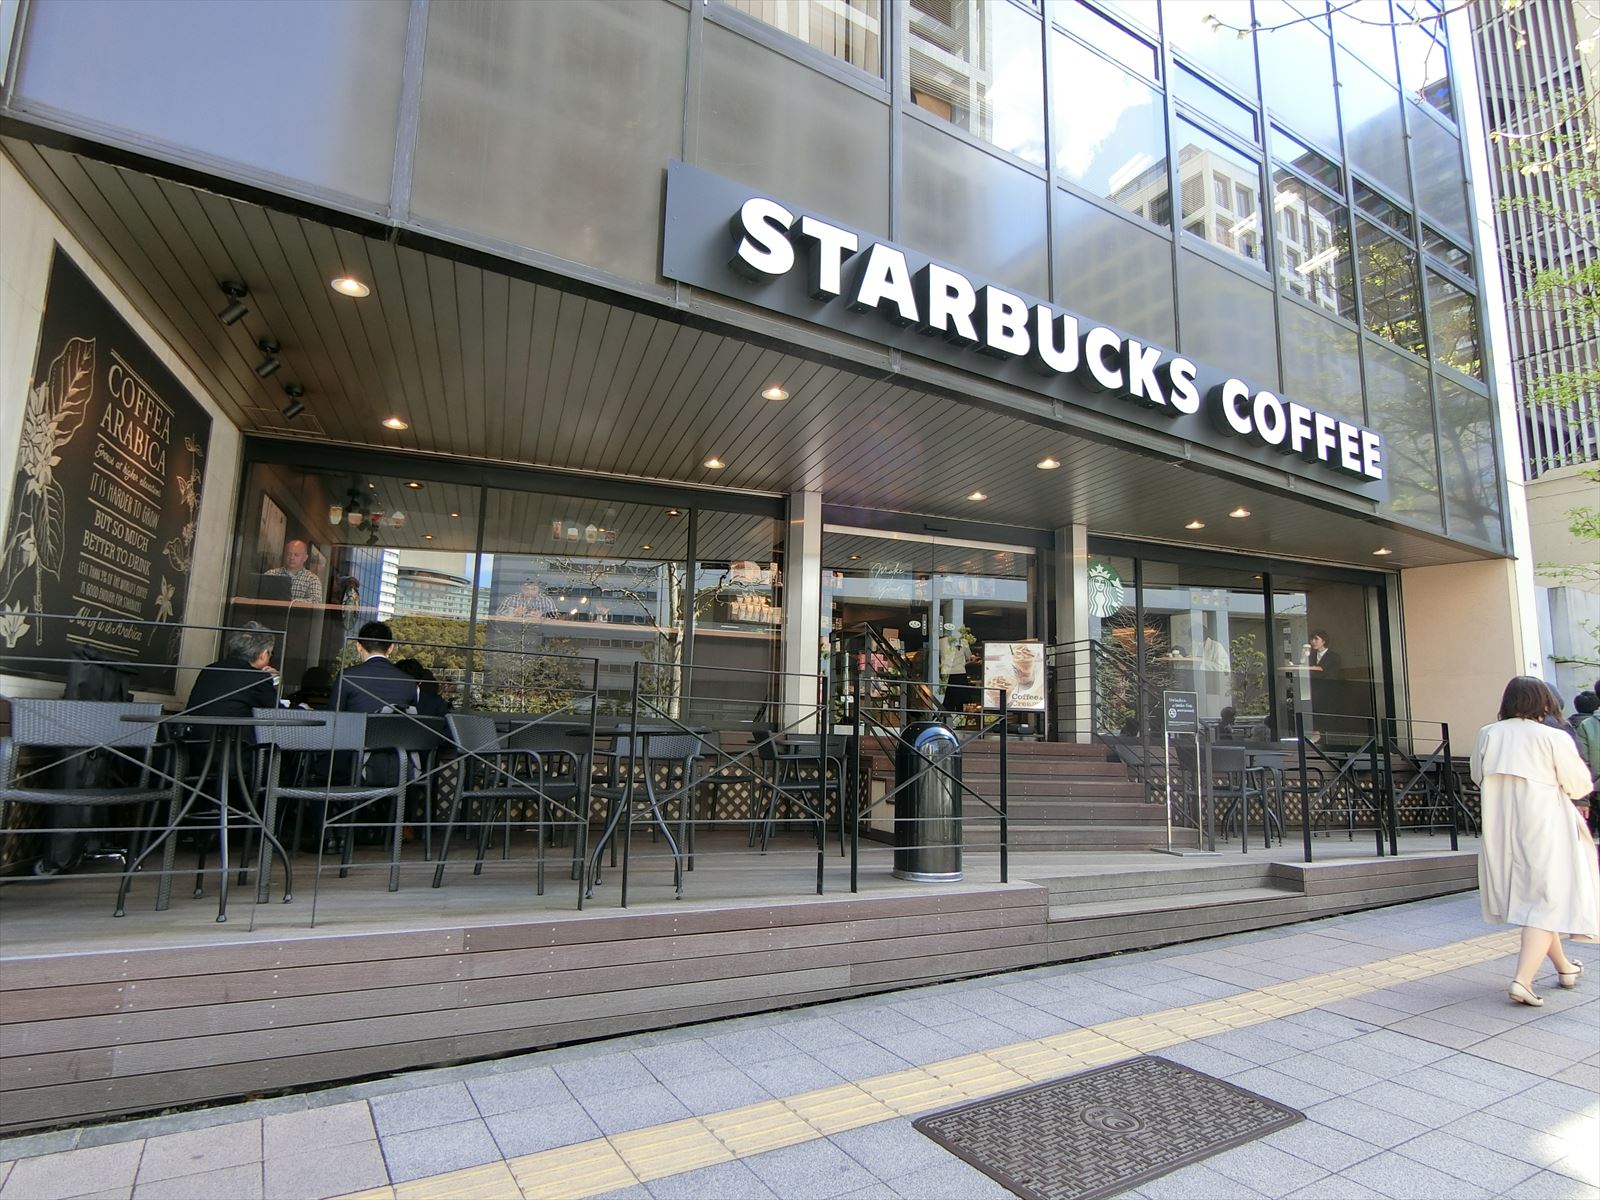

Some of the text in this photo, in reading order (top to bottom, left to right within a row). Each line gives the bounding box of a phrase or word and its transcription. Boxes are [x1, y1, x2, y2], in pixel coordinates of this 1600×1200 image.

[737, 197, 1383, 480] STARBUCKS COFFEE
[108, 364, 170, 445] COFFEA
[94, 444, 115, 466] Grows
[116, 462, 123, 470] at
[122, 462, 138, 481] higher
[100, 402, 166, 477] ARABICA
[90, 472, 161, 529] IT IS HARDER TO GROW
[83, 530, 152, 576] BETTER TO DRINK
[94, 510, 150, 552] BUT SO MUCH
